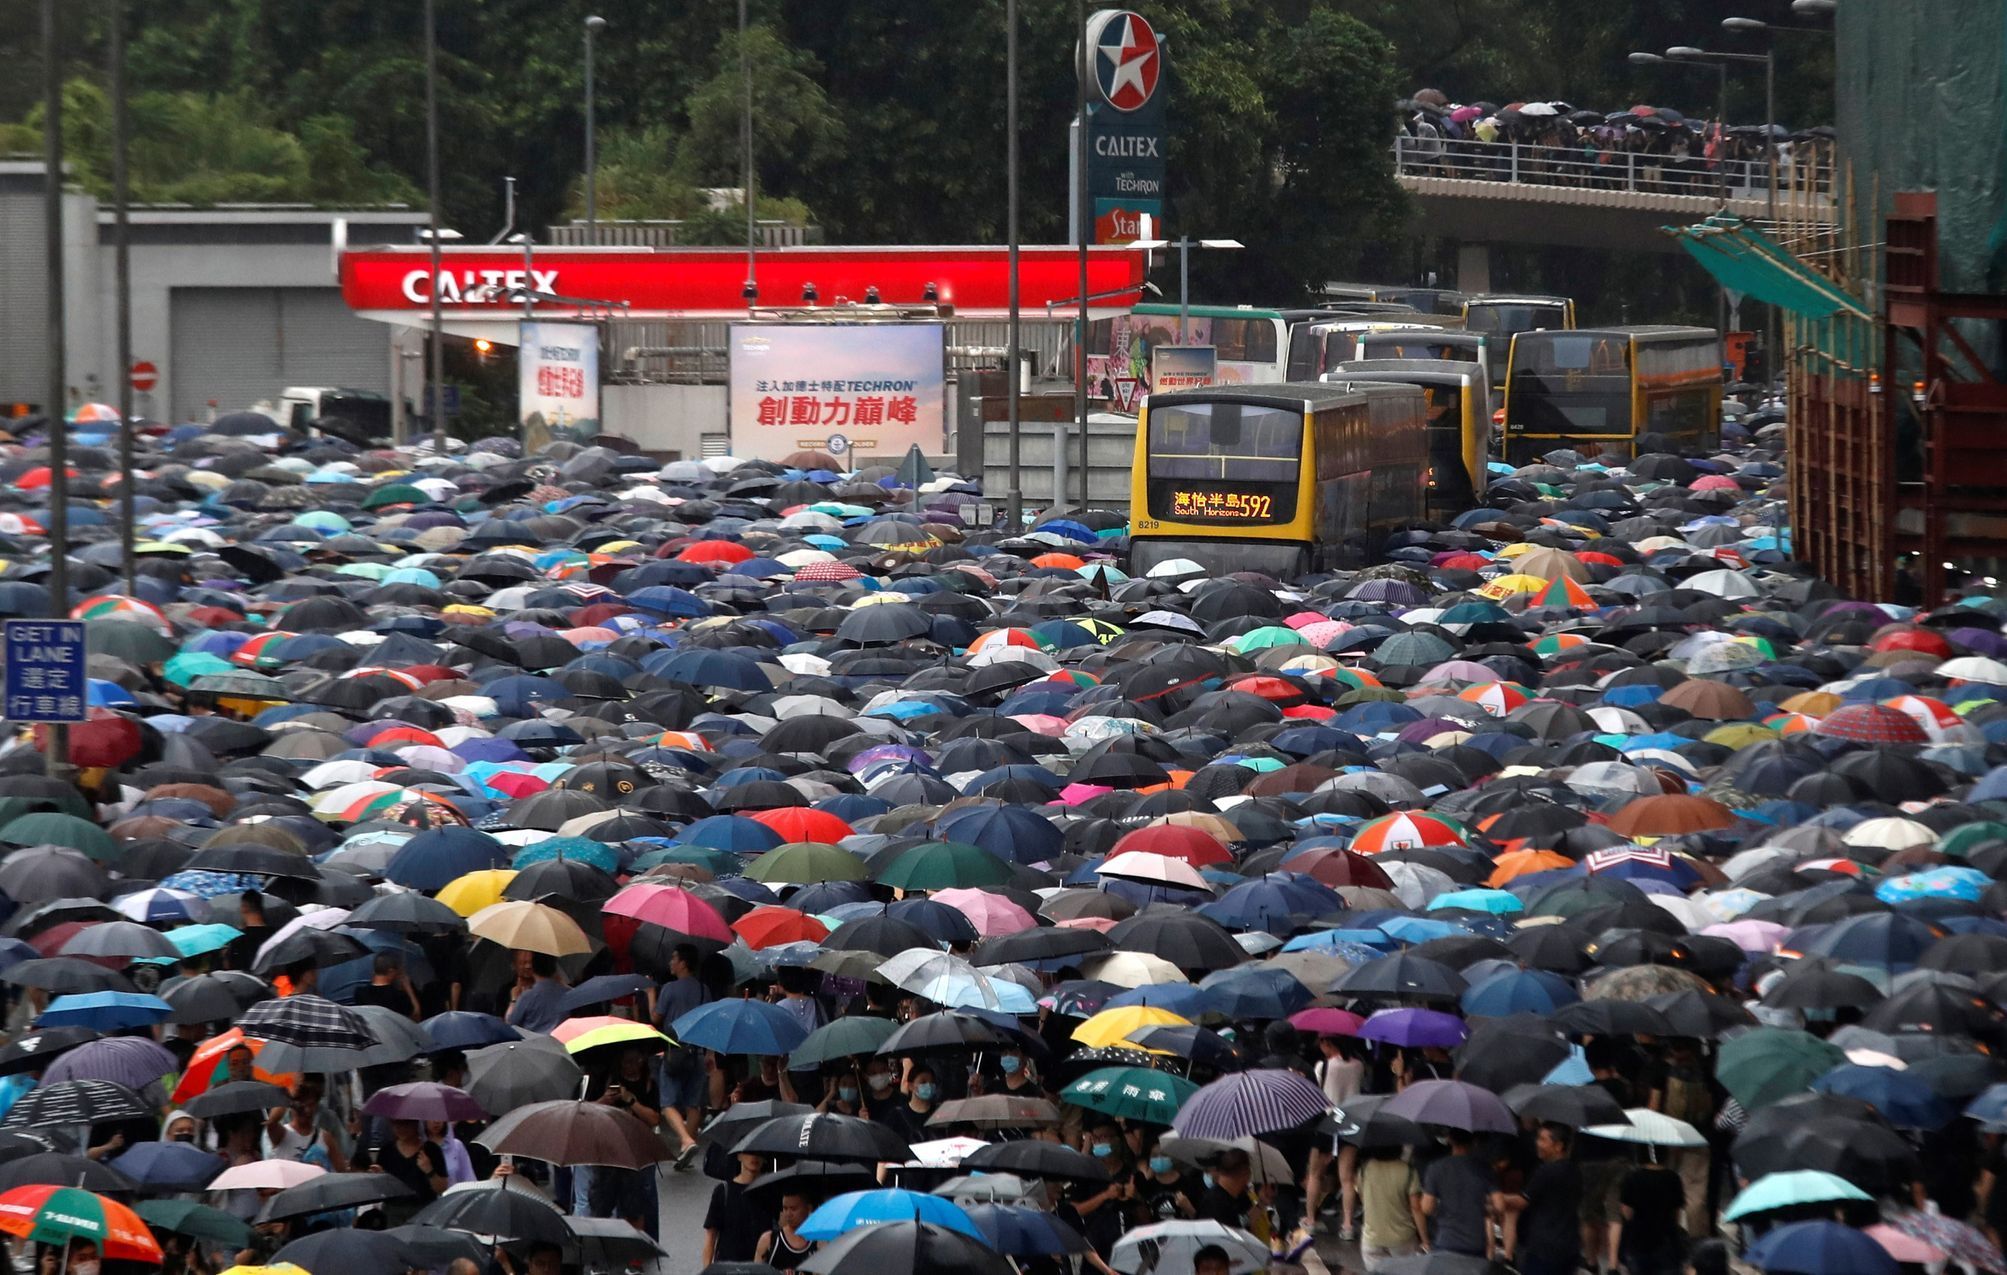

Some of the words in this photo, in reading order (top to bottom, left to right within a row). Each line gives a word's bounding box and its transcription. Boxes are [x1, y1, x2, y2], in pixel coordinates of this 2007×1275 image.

[1095, 135, 1159, 158] CALTEX
[1120, 171, 1135, 179] with
[1115, 177, 1159, 194] TECHRON
[402, 269, 559, 304] CALTEX
[756, 395, 918, 426] 創動力巔峰
[1174, 491, 1241, 508] 海怡半島
[1240, 495, 1271, 518] 592
[1174, 506, 1199, 516] South
[1203, 507, 1240, 517] Horizons
[1138, 520, 1160, 529] 8219
[11, 626, 55, 642] GET
[61, 627, 81, 642] IN
[16, 646, 74, 663] LANE
[21, 667, 70, 689] 選定
[9, 695, 82, 717] 行車線
